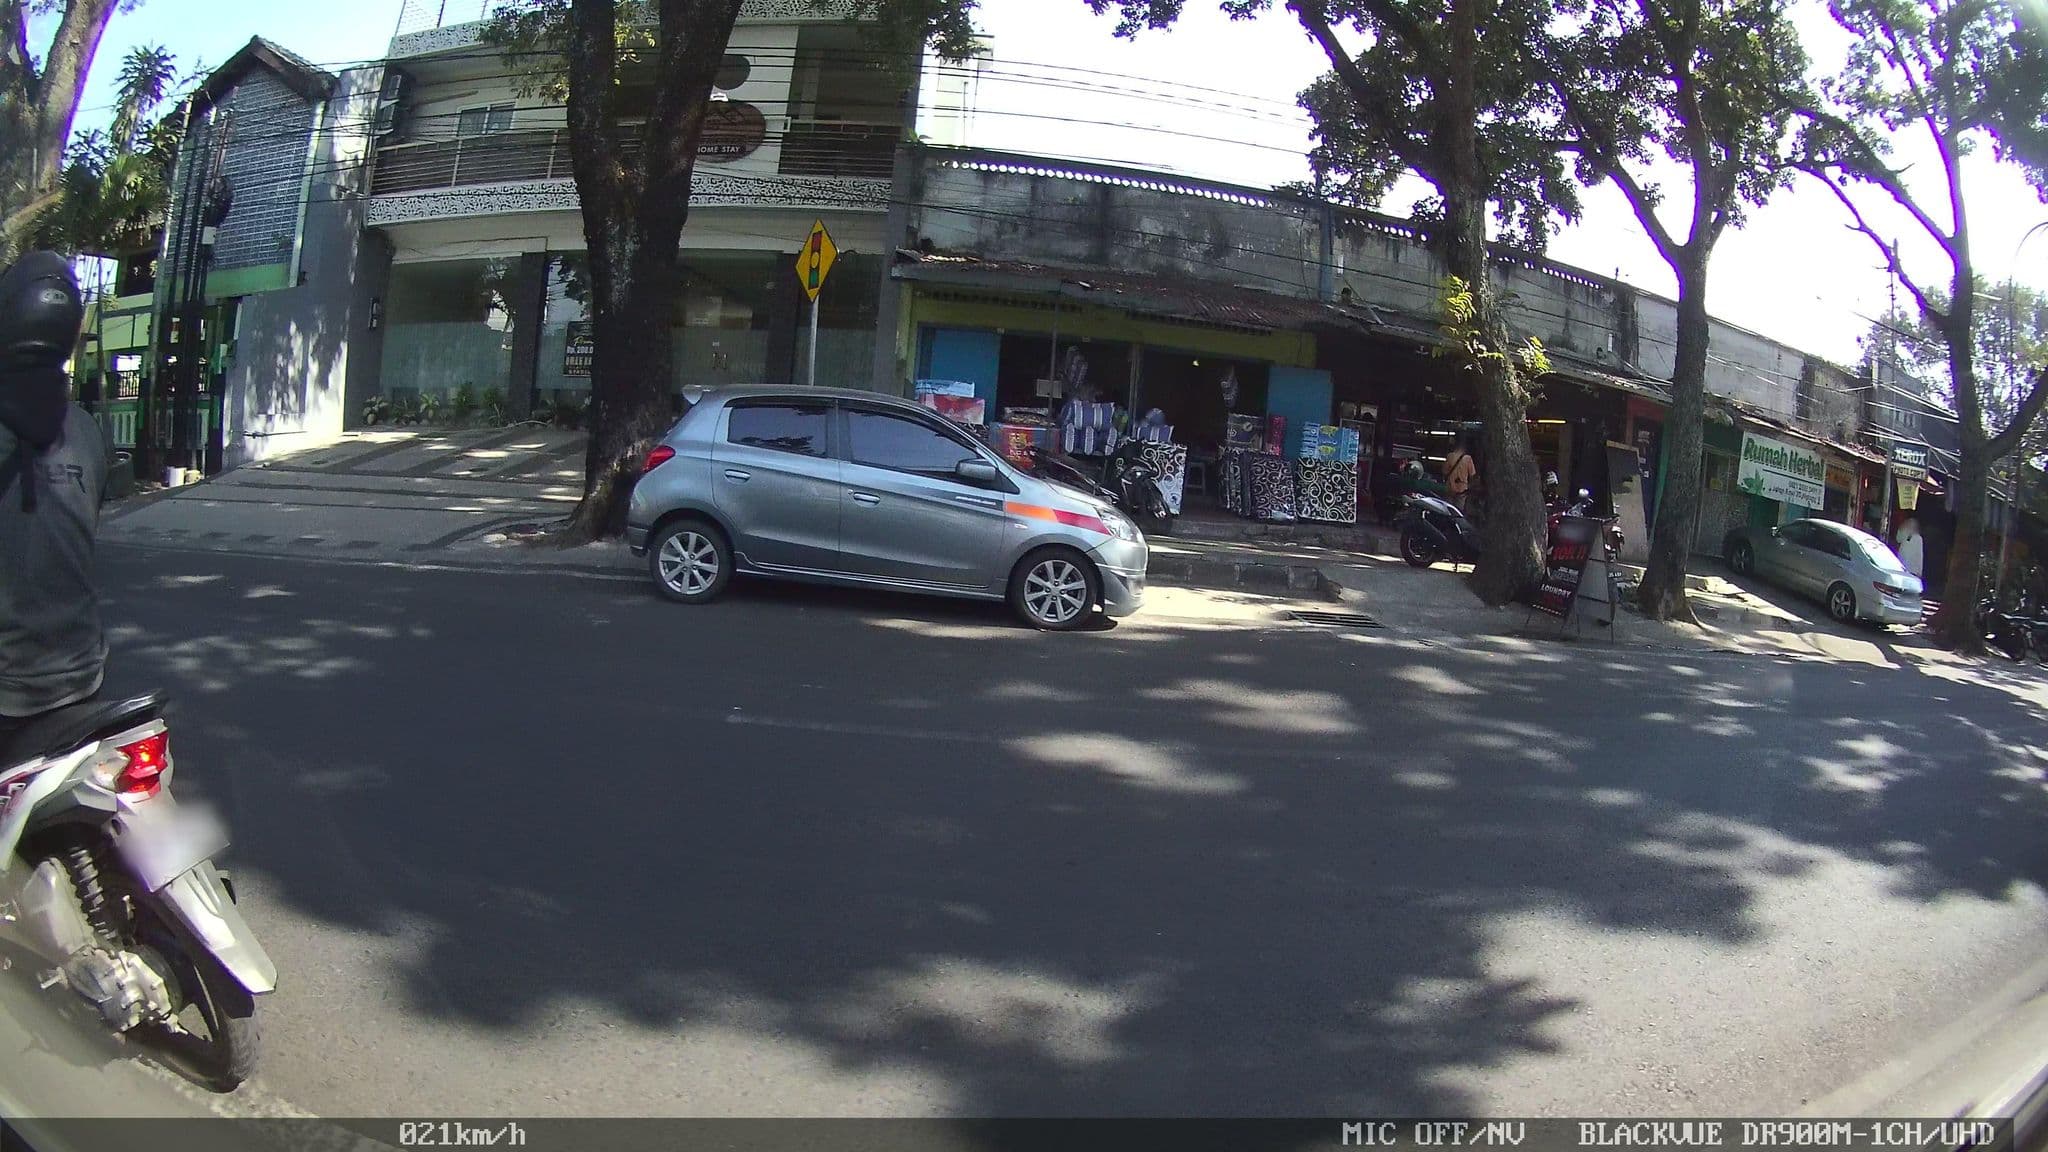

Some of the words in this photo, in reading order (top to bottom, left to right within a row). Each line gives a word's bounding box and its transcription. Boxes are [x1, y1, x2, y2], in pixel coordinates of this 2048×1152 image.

[1744, 437, 1788, 470] Rumah
[1789, 449, 1825, 481] Herbal
[1894, 446, 1927, 467] XEROX
